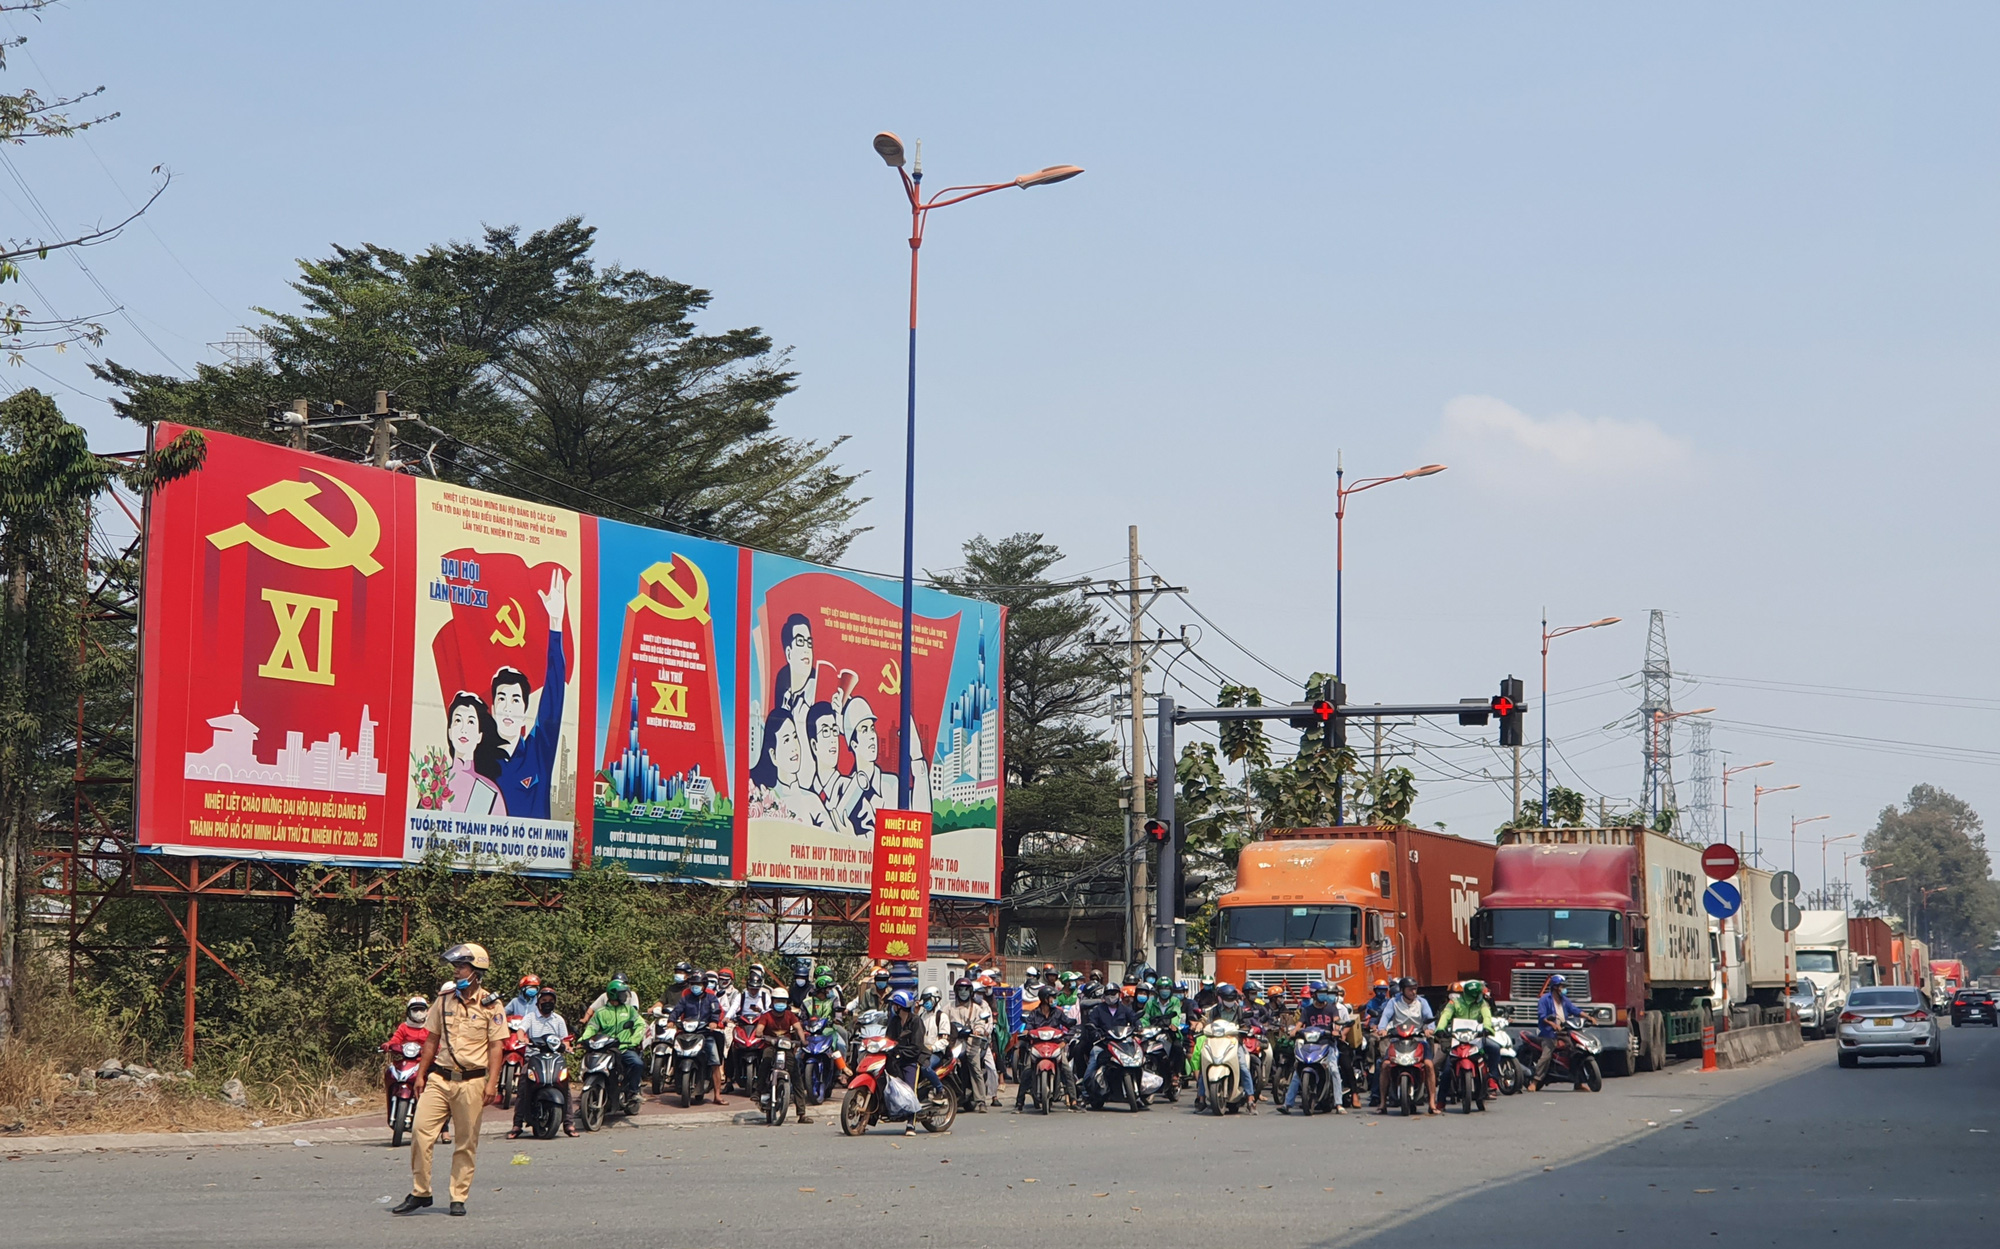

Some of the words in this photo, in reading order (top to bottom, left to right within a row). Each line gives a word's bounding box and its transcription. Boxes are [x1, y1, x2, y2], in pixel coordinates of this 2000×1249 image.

[441, 557, 459, 580] ĐẠI
[461, 559, 480, 584] HỘI
[430, 577, 450, 602] LẦN
[450, 585, 473, 606] THỨ
[472, 589, 488, 608] XI
[258, 587, 338, 686] XI
[651, 681, 688, 718] XI
[204, 790, 225, 814] NHIỆT
[225, 791, 241, 815] LIỆT
[241, 792, 260, 812] CHÀO
[262, 794, 282, 814] MỪNG
[283, 799, 296, 820] ĐẠI
[296, 796, 308, 821] HỘI
[309, 801, 321, 822] ĐẠI
[322, 794, 337, 818] BIỂU
[338, 798, 356, 820] ĐẢNG
[357, 802, 367, 825] BỘ
[189, 816, 213, 836] THÀNH
[214, 815, 230, 838] PHỐ
[230, 816, 241, 838] HỒ
[241, 820, 254, 839] CHÍ
[254, 824, 271, 840] MINH
[273, 819, 286, 842] LẦN
[288, 823, 302, 843] THỨ
[312, 825, 332, 848] NHIỆM
[333, 826, 342, 845] KỲ
[343, 831, 358, 846] 2020
[362, 832, 378, 848] 2025
[436, 817, 452, 833] TRẺ
[456, 820, 487, 836] THÀNH
[490, 821, 509, 837] PHỐ
[512, 822, 525, 838] HỒ
[528, 825, 542, 839] CHÍ
[545, 828, 568, 841] MINH
[885, 817, 906, 832] NHIỆT
[907, 820, 921, 834] LIỆT
[412, 836, 424, 852] TỰ
[502, 841, 524, 856] DƯỚI
[541, 843, 565, 859] ĐẢNG
[881, 835, 900, 847] CHÀO
[902, 836, 923, 849] MỪNG
[790, 843, 810, 859] PHÁT
[812, 846, 827, 861] HUY
[829, 844, 856, 863] TRUYỀN
[858, 847, 872, 864] THỐ
[888, 854, 900, 867] ĐẠI
[902, 852, 915, 867] HỘI
[752, 860, 767, 877] XÂY
[770, 862, 791, 880] DỰNG
[793, 864, 818, 880] THÀNH
[821, 863, 835, 881] PHỐ
[837, 864, 847, 883] HỒ
[850, 867, 862, 883] CHÍ
[930, 855, 944, 871] ÁNG
[946, 858, 959, 874] TẠO
[885, 871, 898, 884] ĐẠI
[900, 868, 917, 883] BIỂU
[934, 877, 946, 893] THỊ
[948, 877, 970, 893] THÔNG
[972, 881, 989, 894] MINH
[880, 887, 899, 900] TOÀN
[901, 886, 920, 900] QUỐC
[892, 904, 907, 917] THỨ
[909, 907, 923, 918] XIII
[880, 920, 895, 934] CỦA
[896, 920, 916, 935] ĐẢNG
[1310, 1015, 1331, 1026] GAP
